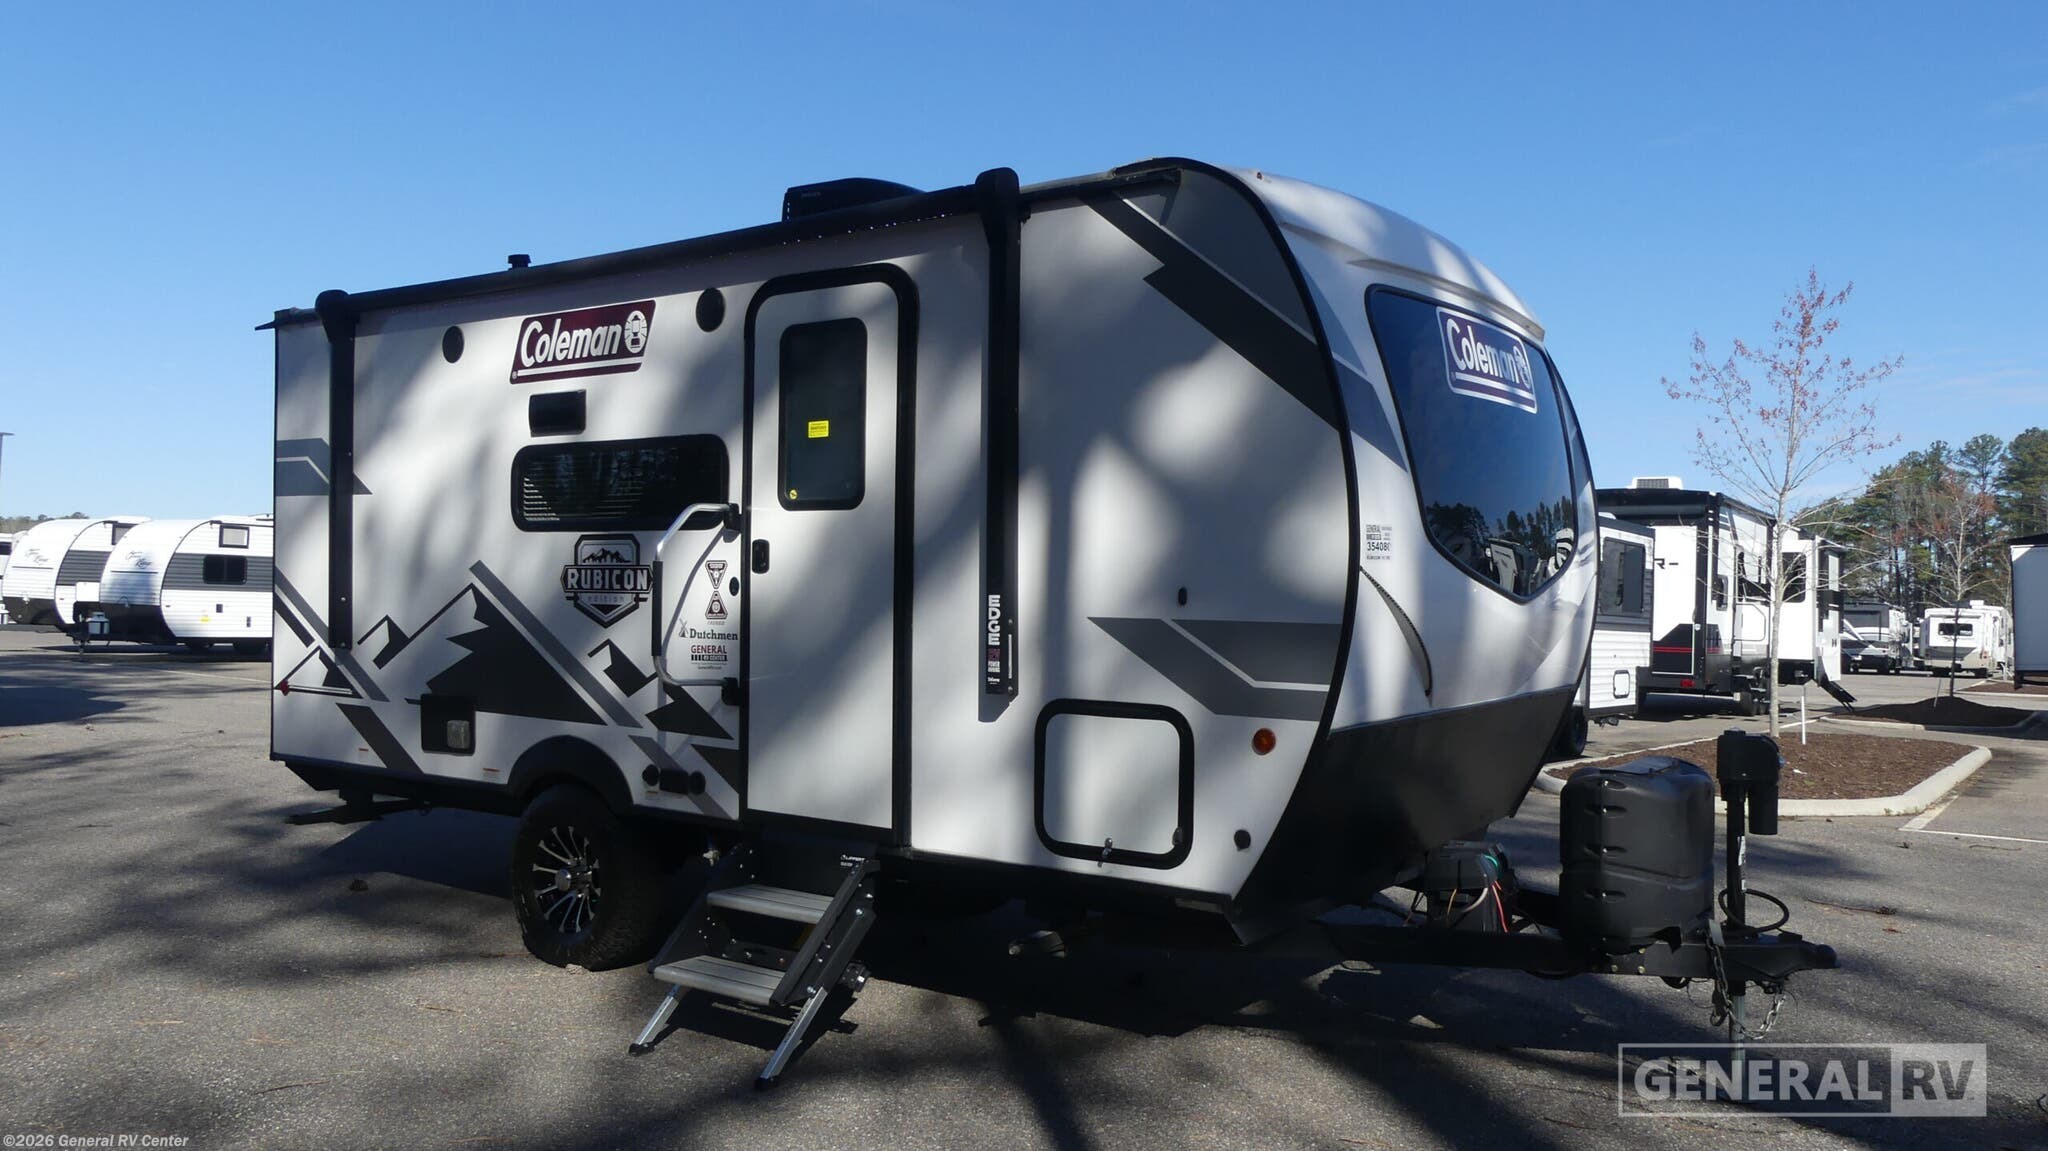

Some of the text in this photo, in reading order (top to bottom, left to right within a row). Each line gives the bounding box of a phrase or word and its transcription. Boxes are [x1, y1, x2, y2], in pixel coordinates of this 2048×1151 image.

[521, 318, 623, 368] Coleman
[1446, 318, 1519, 384] Coleman
[567, 568, 648, 590] RUBICON
[689, 628, 738, 641] Dutchmen
[988, 594, 1001, 646] EDGE
[690, 644, 728, 655] GENERAL
